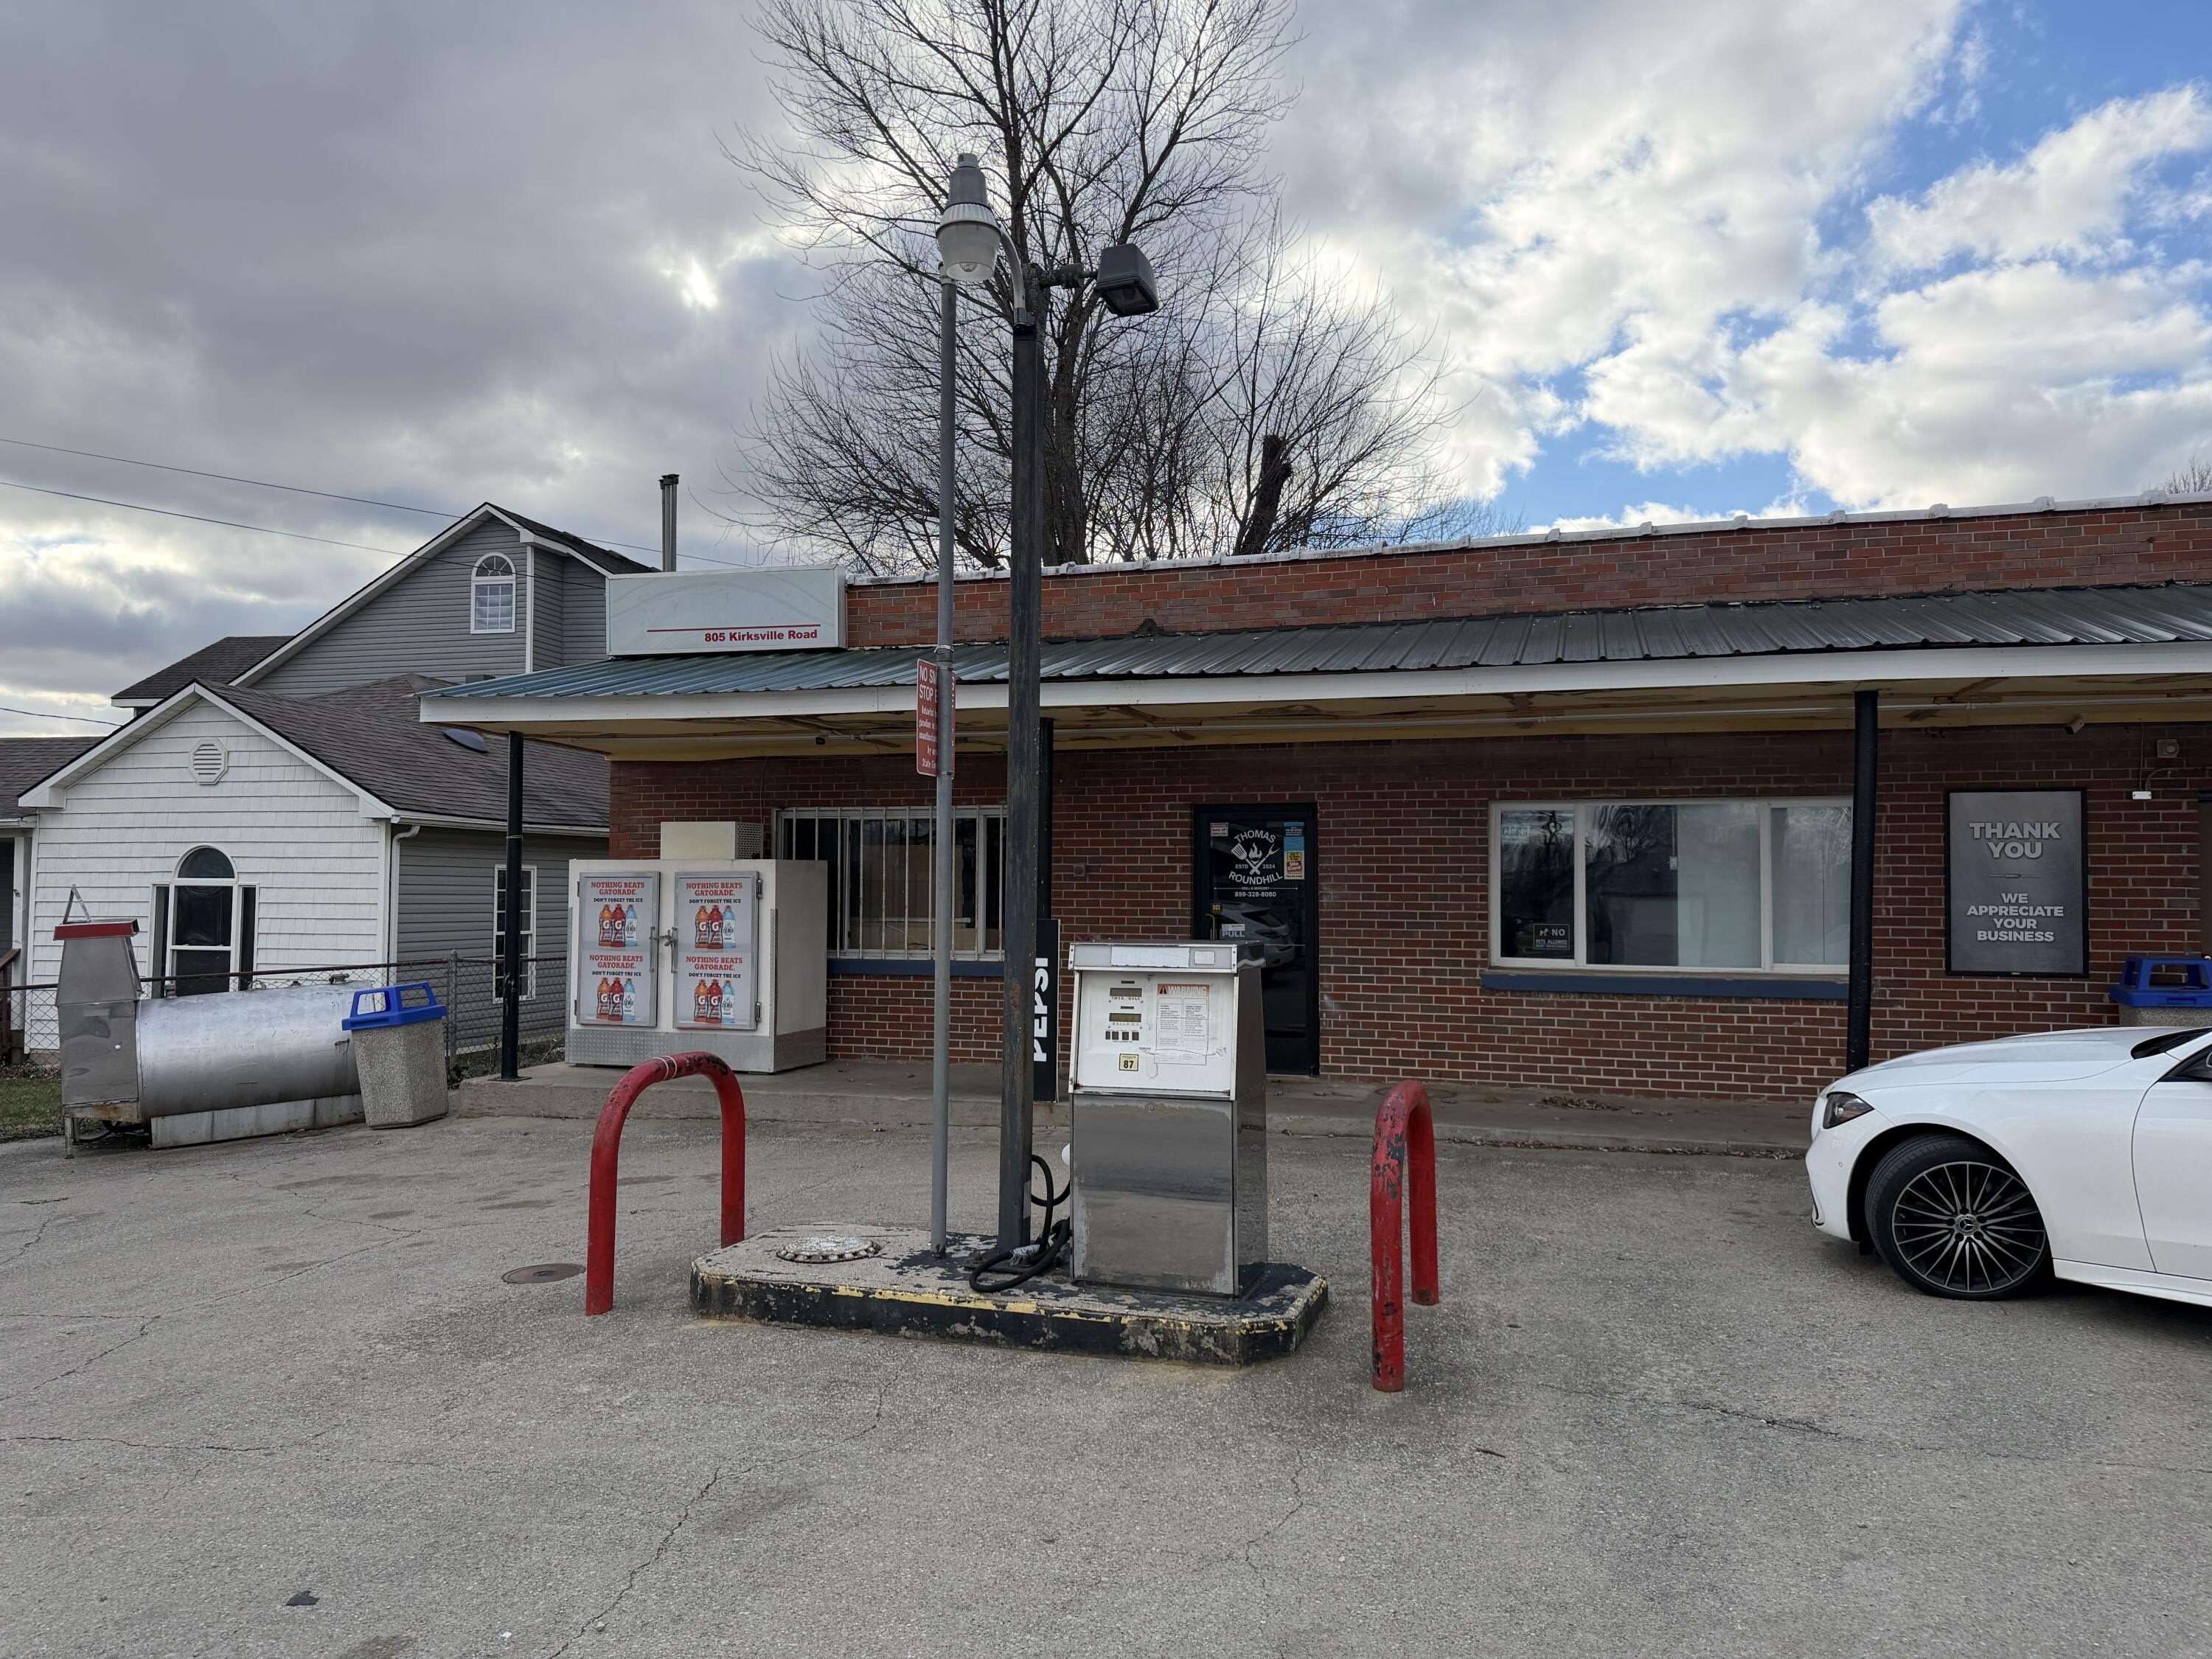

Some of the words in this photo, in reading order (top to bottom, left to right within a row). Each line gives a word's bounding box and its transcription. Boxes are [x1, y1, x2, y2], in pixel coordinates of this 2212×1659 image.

[705, 633, 726, 641] 805
[729, 631, 785, 641] Kirksville
[788, 630, 818, 639] Road
[919, 666, 928, 681] NO
[919, 684, 933, 701] STOP
[1969, 822, 2061, 839] THANK
[1234, 830, 1276, 844] THOMAS
[1988, 841, 2042, 858] YOU
[1228, 871, 1283, 885] ROUNDHILL
[2001, 893, 2028, 903] WE
[1966, 905, 2064, 917] APPRECIATE
[603, 921, 610, 929] G
[615, 921, 622, 929] G
[700, 922, 706, 931] G
[712, 922, 719, 931] G
[1993, 918, 2037, 929] YOUR
[1551, 928, 1565, 936] NO
[1977, 931, 2054, 942] BUSINESS
[1168, 986, 1207, 995] WARNING
[601, 994, 608, 1002] G
[613, 994, 620, 1003] G
[698, 996, 706, 1004] G
[711, 996, 718, 1006] G
[1124, 1060, 1134, 1068] 87
